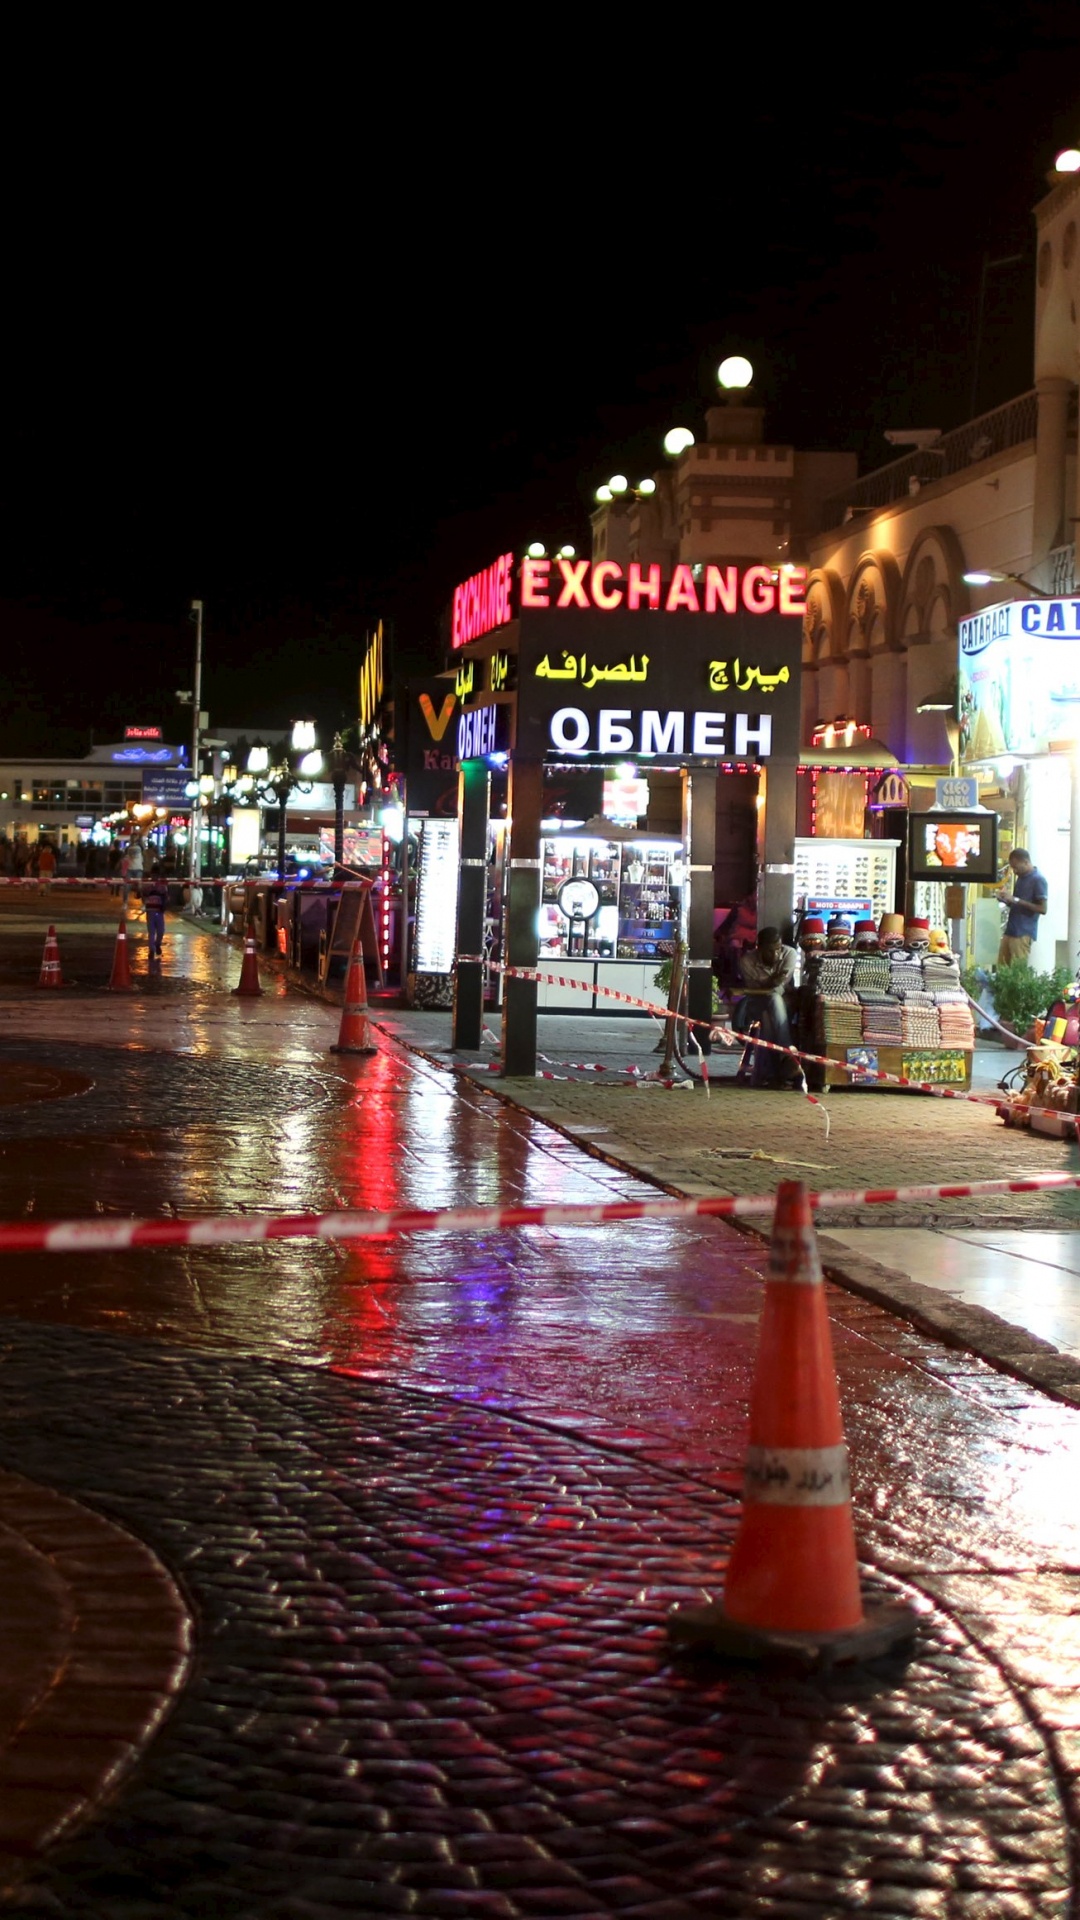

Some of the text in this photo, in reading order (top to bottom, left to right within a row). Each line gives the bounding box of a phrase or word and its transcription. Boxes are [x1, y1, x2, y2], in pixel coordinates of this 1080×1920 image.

[452, 552, 513, 649] EXCHANGE
[521, 559, 808, 615] EXCHANGE
[961, 607, 1010, 649] CATARACT
[458, 704, 497, 760] ОБМЕН
[549, 707, 772, 756] ОБМЕН
[943, 780, 970, 795] CLEO
[943, 795, 970, 807] PARK
